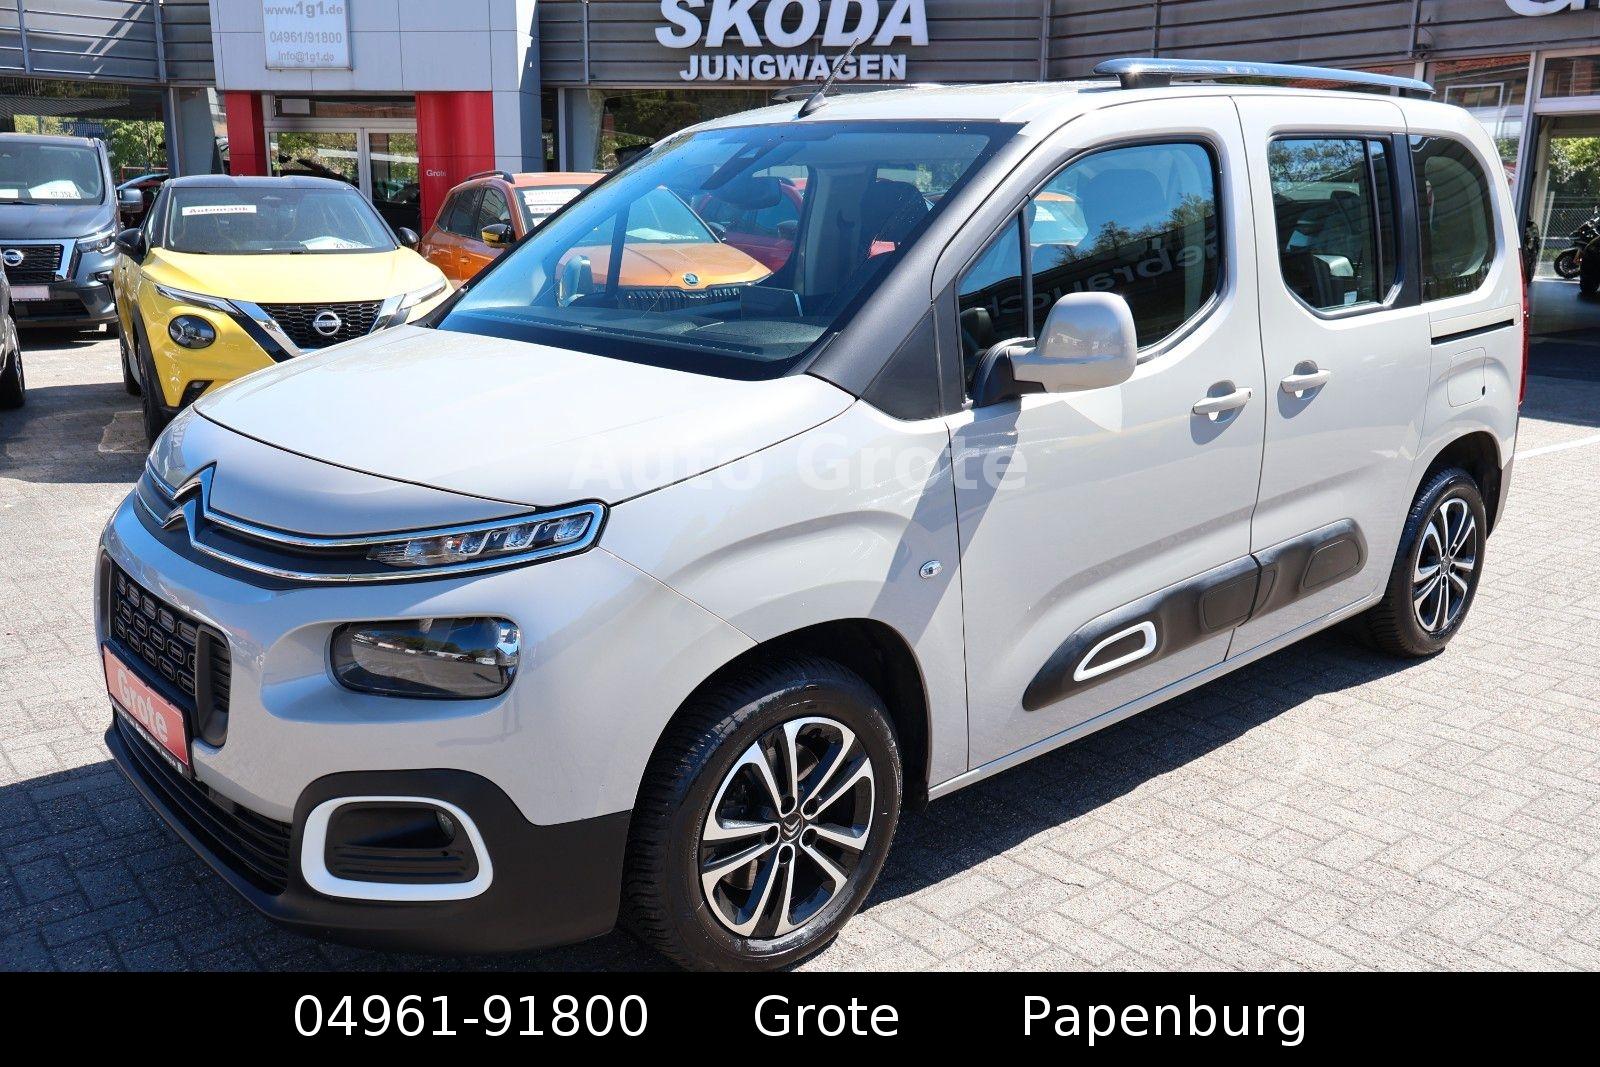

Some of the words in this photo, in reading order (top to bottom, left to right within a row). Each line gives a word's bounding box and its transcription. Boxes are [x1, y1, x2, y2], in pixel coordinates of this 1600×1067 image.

[264, 1, 343, 18] www.1g1.de
[269, 31, 342, 43] 04961/91800
[679, 54, 906, 81] JUNGWAGEN
[117, 668, 168, 744] Grote
